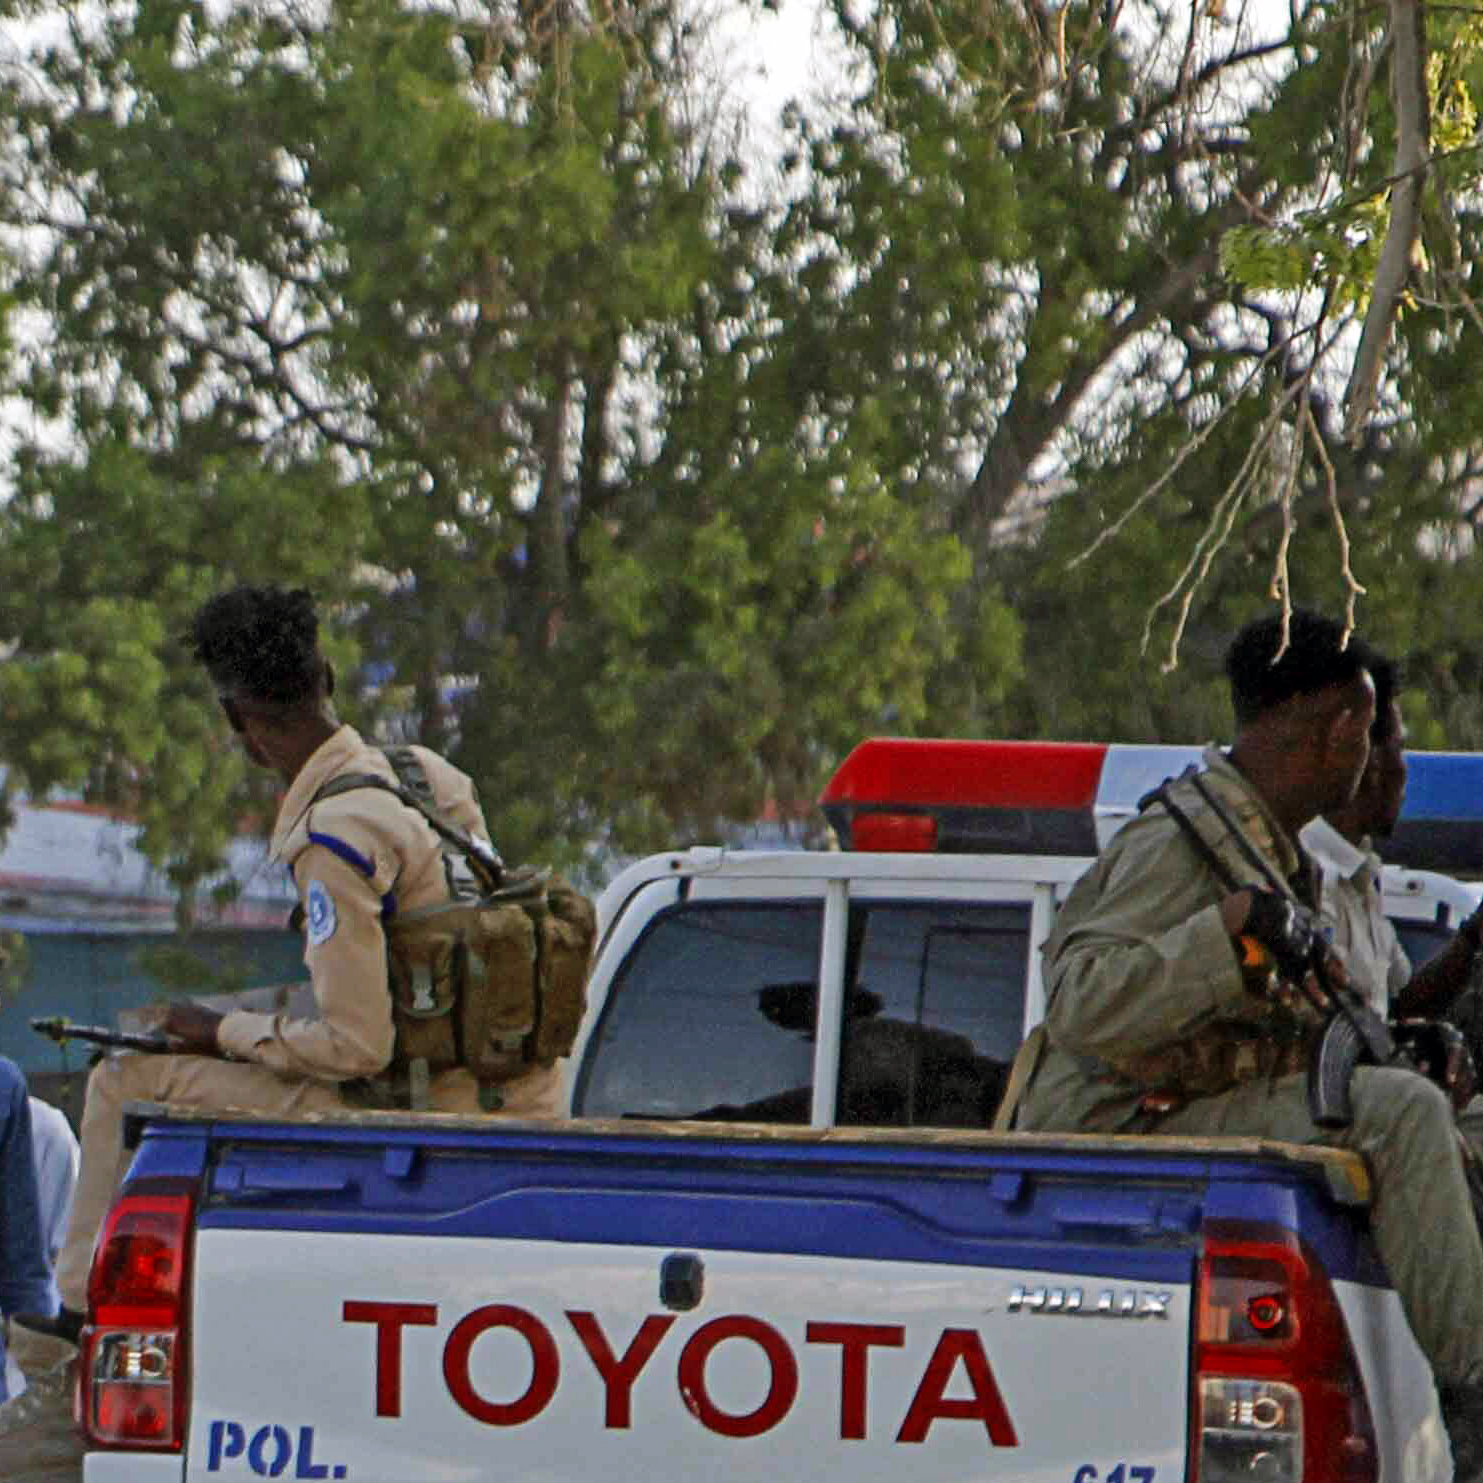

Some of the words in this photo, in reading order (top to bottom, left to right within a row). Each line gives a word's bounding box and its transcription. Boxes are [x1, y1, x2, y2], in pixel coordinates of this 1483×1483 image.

[1008, 1285, 1172, 1318] HILUX
[342, 1300, 1020, 1448] TOYOTA
[207, 1420, 347, 1480] POL.
